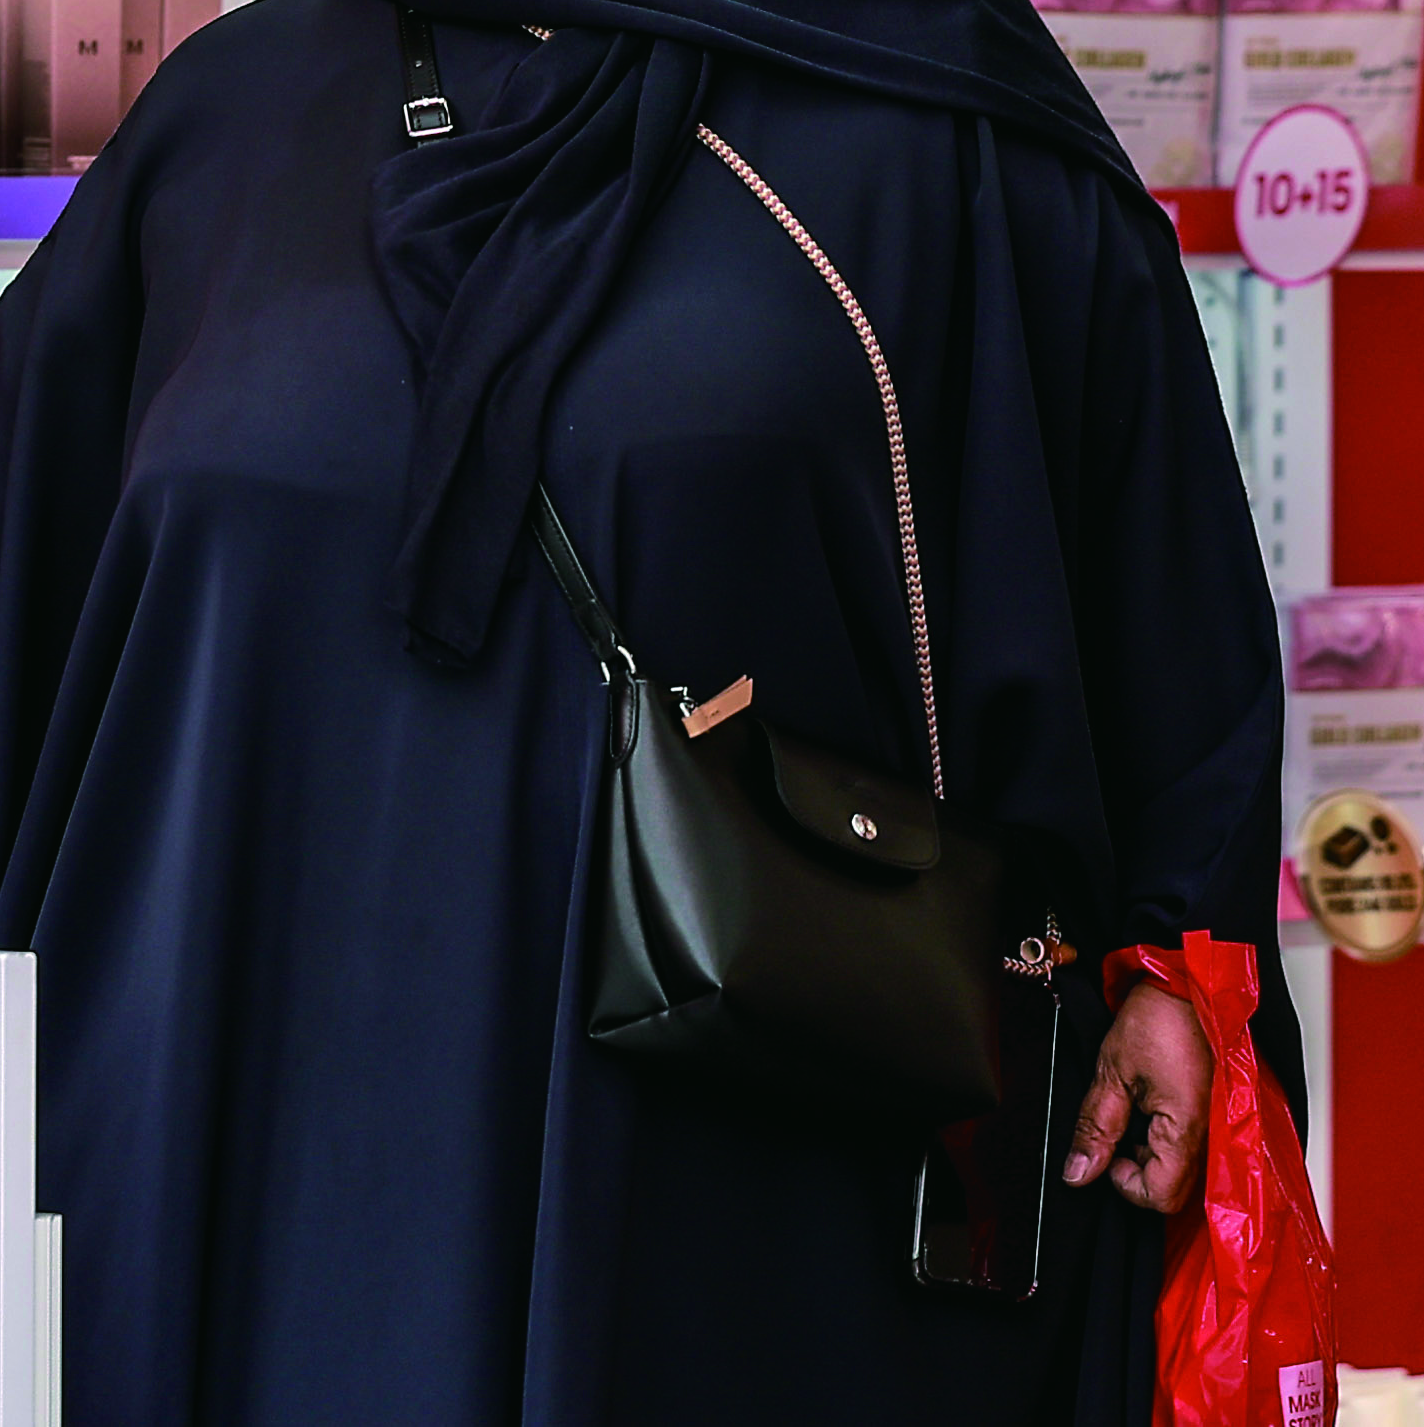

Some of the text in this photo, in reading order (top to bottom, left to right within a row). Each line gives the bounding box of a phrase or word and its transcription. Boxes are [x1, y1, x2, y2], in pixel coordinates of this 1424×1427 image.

[1256, 169, 1354, 218] 10+15
[1297, 1369, 1316, 1388] ALL
[1288, 1390, 1320, 1414] MASK
